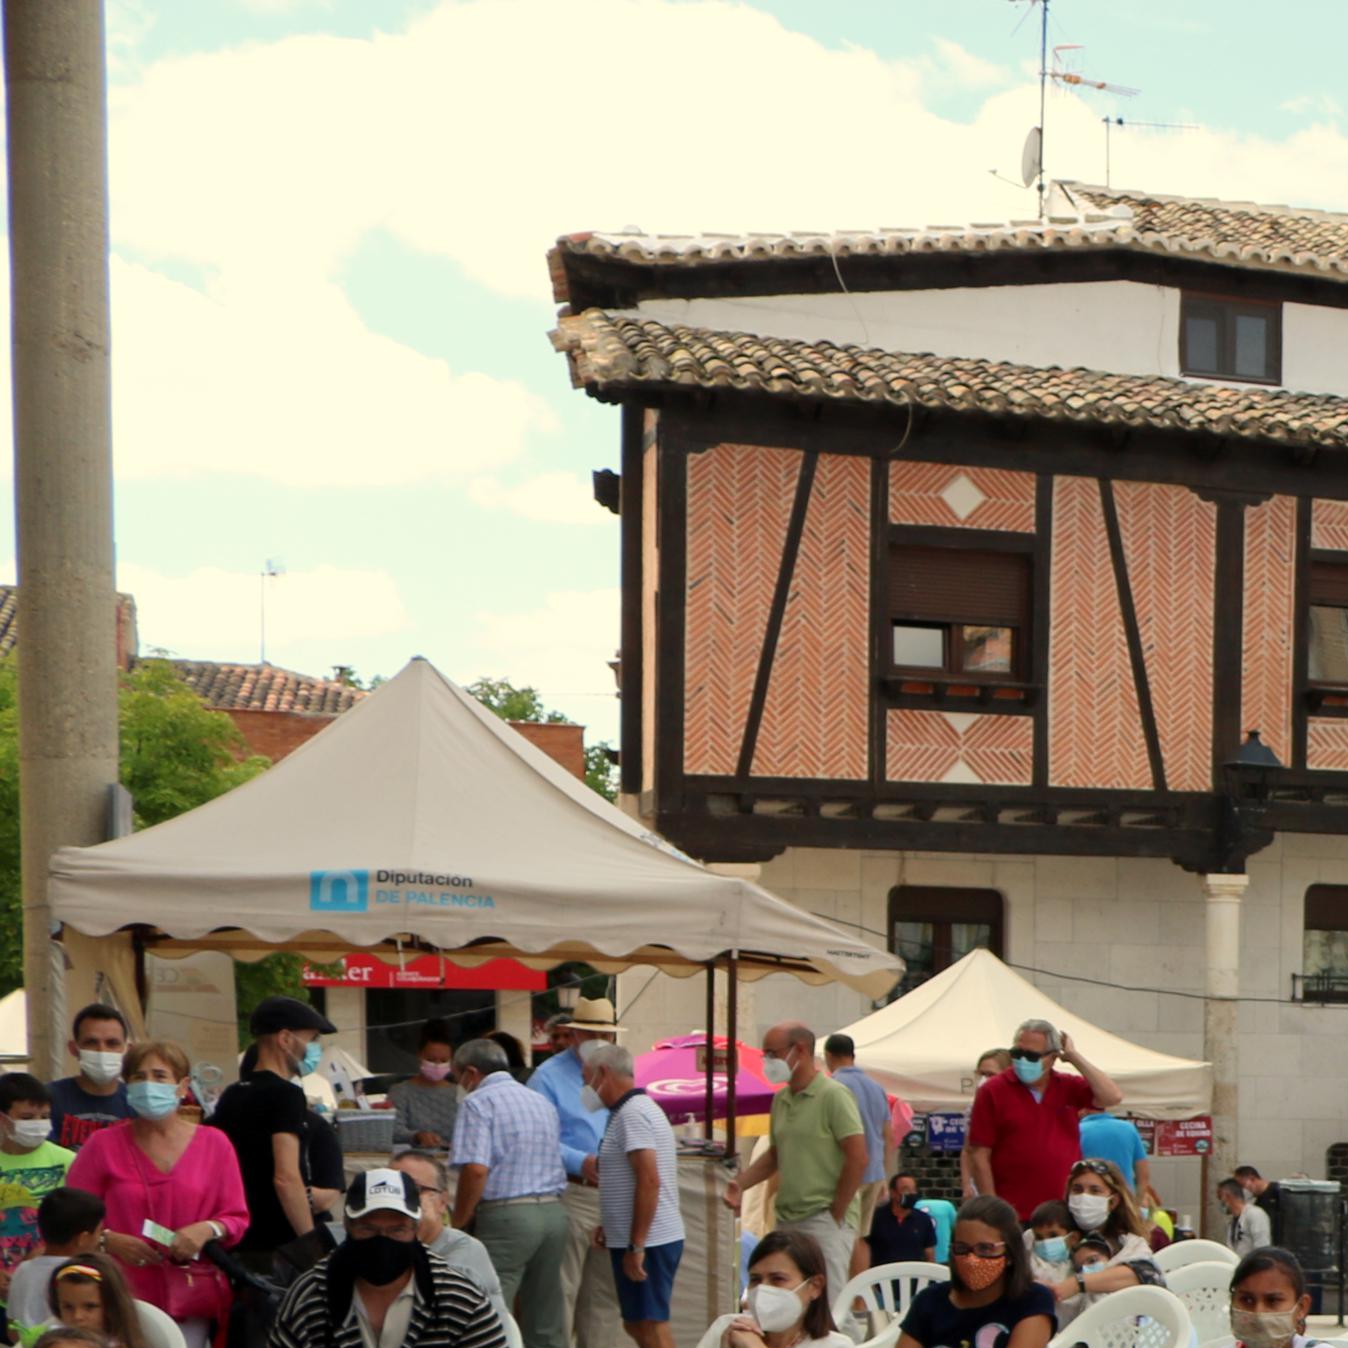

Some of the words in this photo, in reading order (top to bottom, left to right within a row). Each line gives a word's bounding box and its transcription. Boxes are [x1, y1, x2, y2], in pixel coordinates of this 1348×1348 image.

[376, 889, 400, 904] DE
[404, 891, 496, 909] PALENCIA
[369, 1185, 402, 1196] LOTUS
